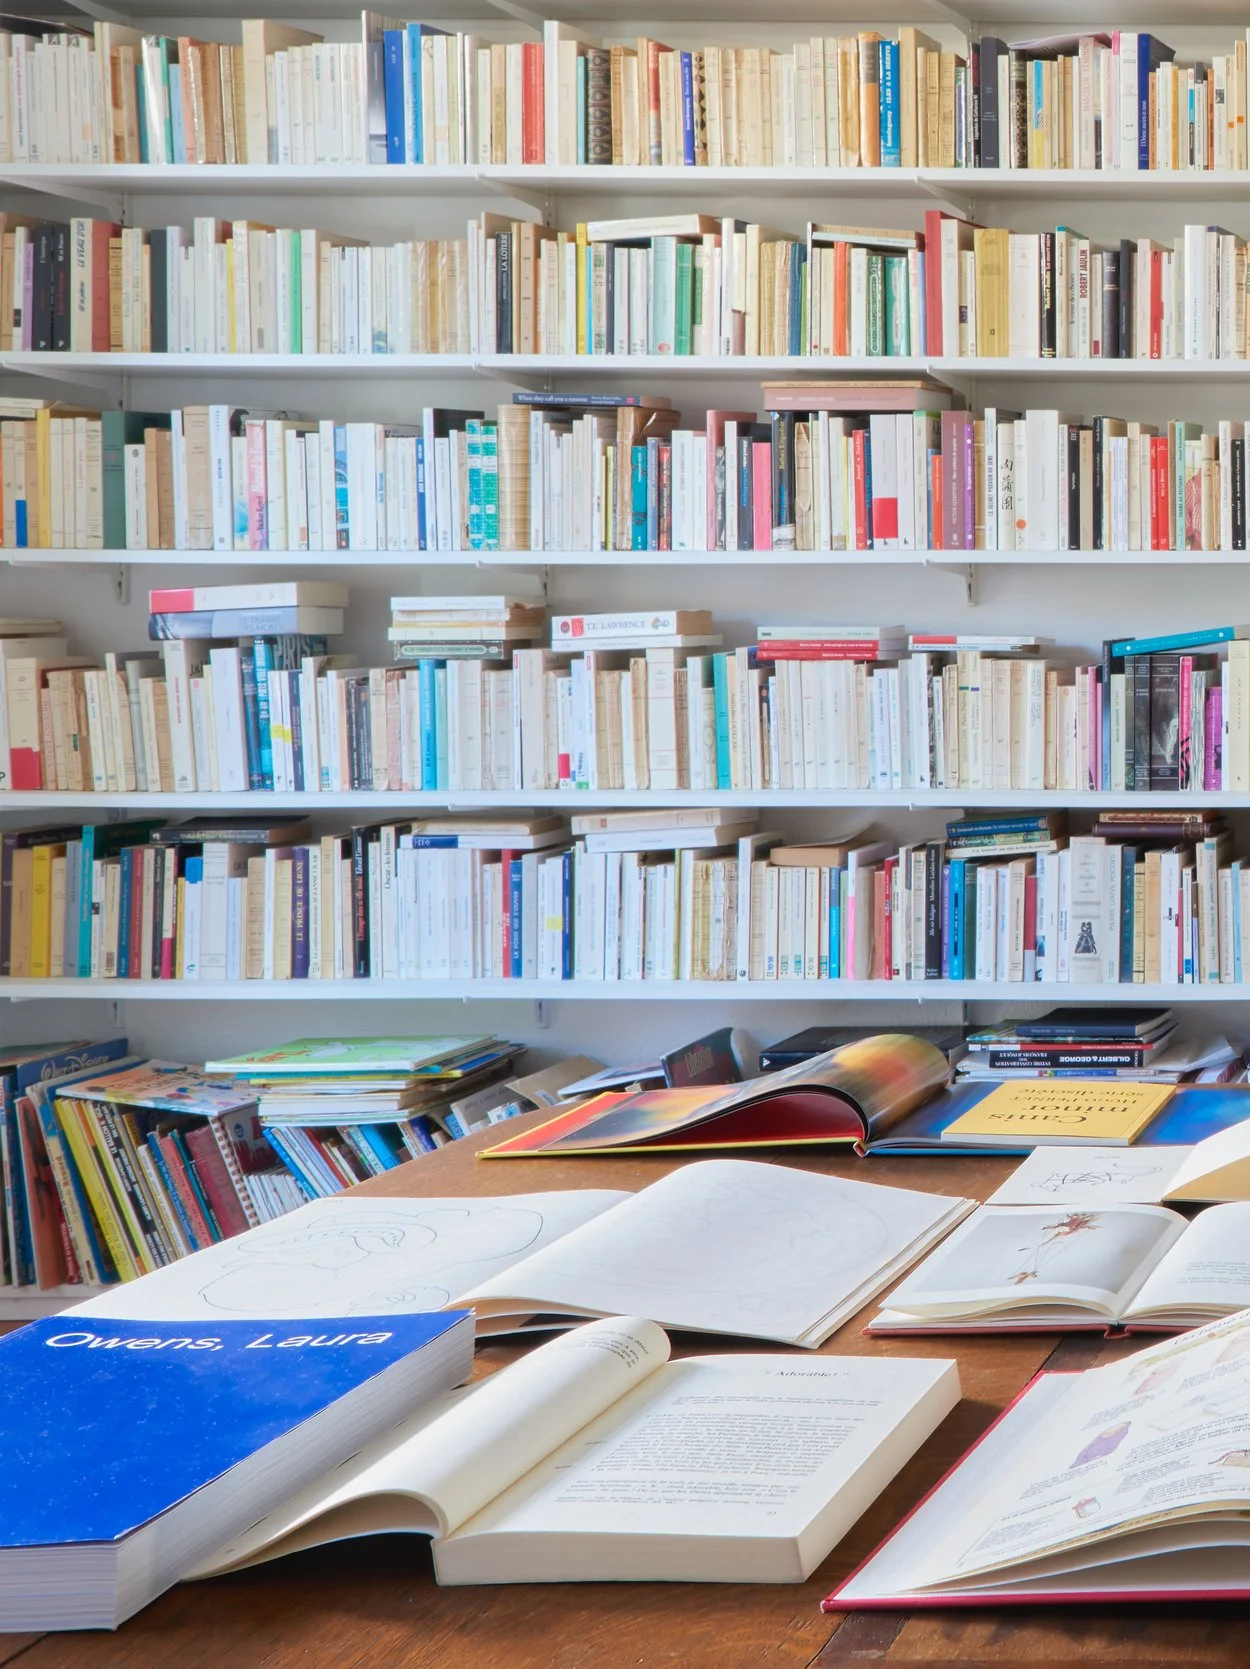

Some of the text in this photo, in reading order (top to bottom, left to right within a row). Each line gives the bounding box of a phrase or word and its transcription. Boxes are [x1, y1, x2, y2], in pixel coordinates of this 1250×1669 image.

[77, 239, 85, 258] VEAU
[500, 234, 508, 271] LA LOTERIE
[77, 260, 85, 268] LE
[1080, 249, 1088, 271] JAULIN
[1080, 273, 1088, 298] ROBERT
[601, 620, 646, 630] LAWRENCE
[296, 886, 303, 896] DE
[296, 931, 303, 940] LE
[1023, 1105, 1128, 1115] minor
[988, 1114, 1087, 1124] Canis
[44, 1329, 393, 1351] Owens, Laura
